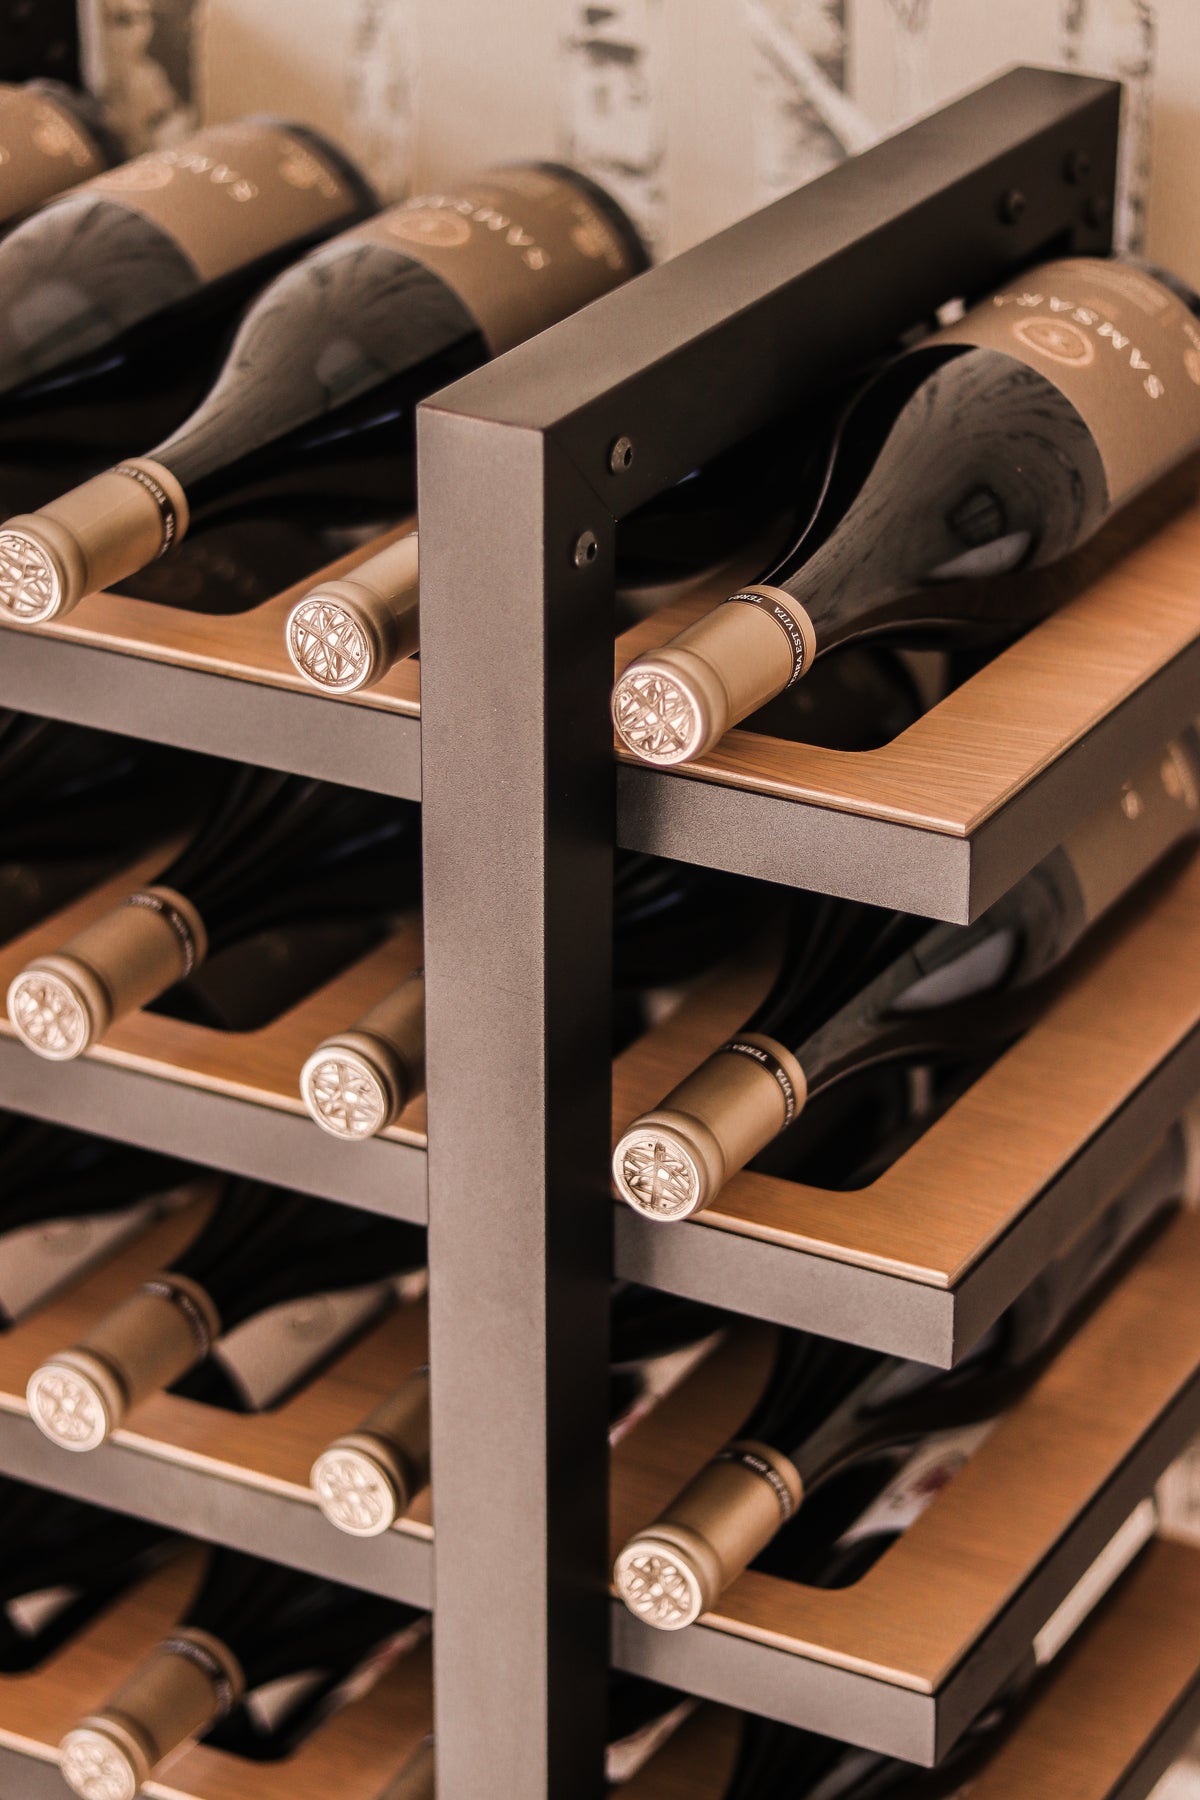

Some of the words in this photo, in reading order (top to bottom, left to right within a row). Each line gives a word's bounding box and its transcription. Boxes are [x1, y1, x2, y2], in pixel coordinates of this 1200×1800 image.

[774, 606, 793, 631] VITA
[791, 632, 802, 653] EST
[775, 1068, 792, 1097] VITA
